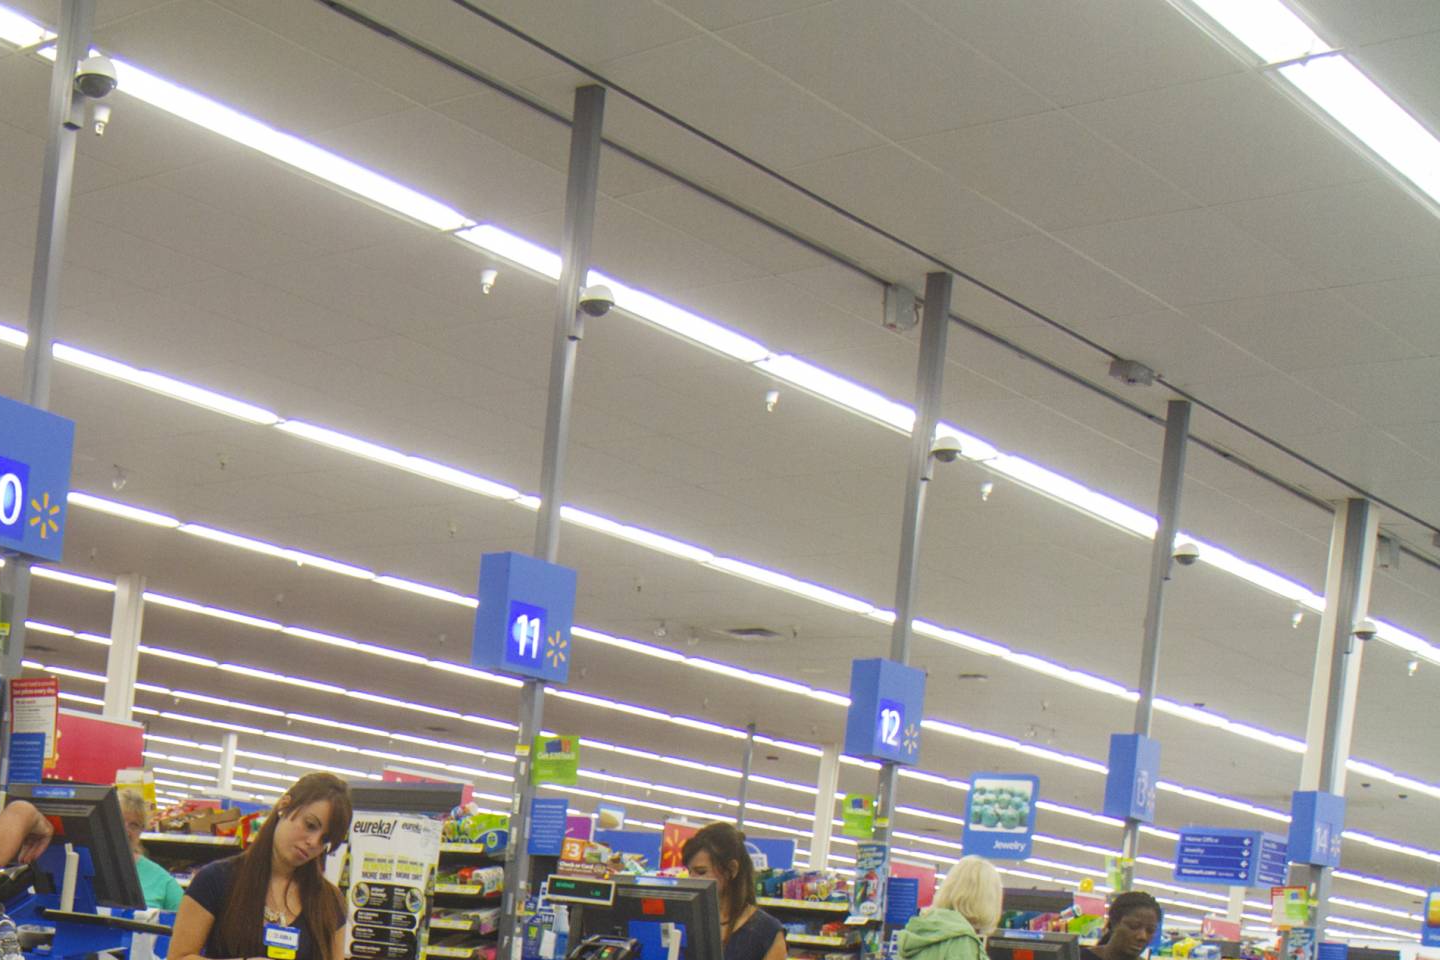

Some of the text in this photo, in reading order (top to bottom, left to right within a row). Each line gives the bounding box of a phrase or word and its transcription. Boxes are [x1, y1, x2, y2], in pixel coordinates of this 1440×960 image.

[516, 613, 541, 659] 11
[880, 708, 901, 747] 12
[353, 819, 398, 836] eureka!
[565, 842, 581, 858] $3
[992, 839, 1027, 852] Jewelry
